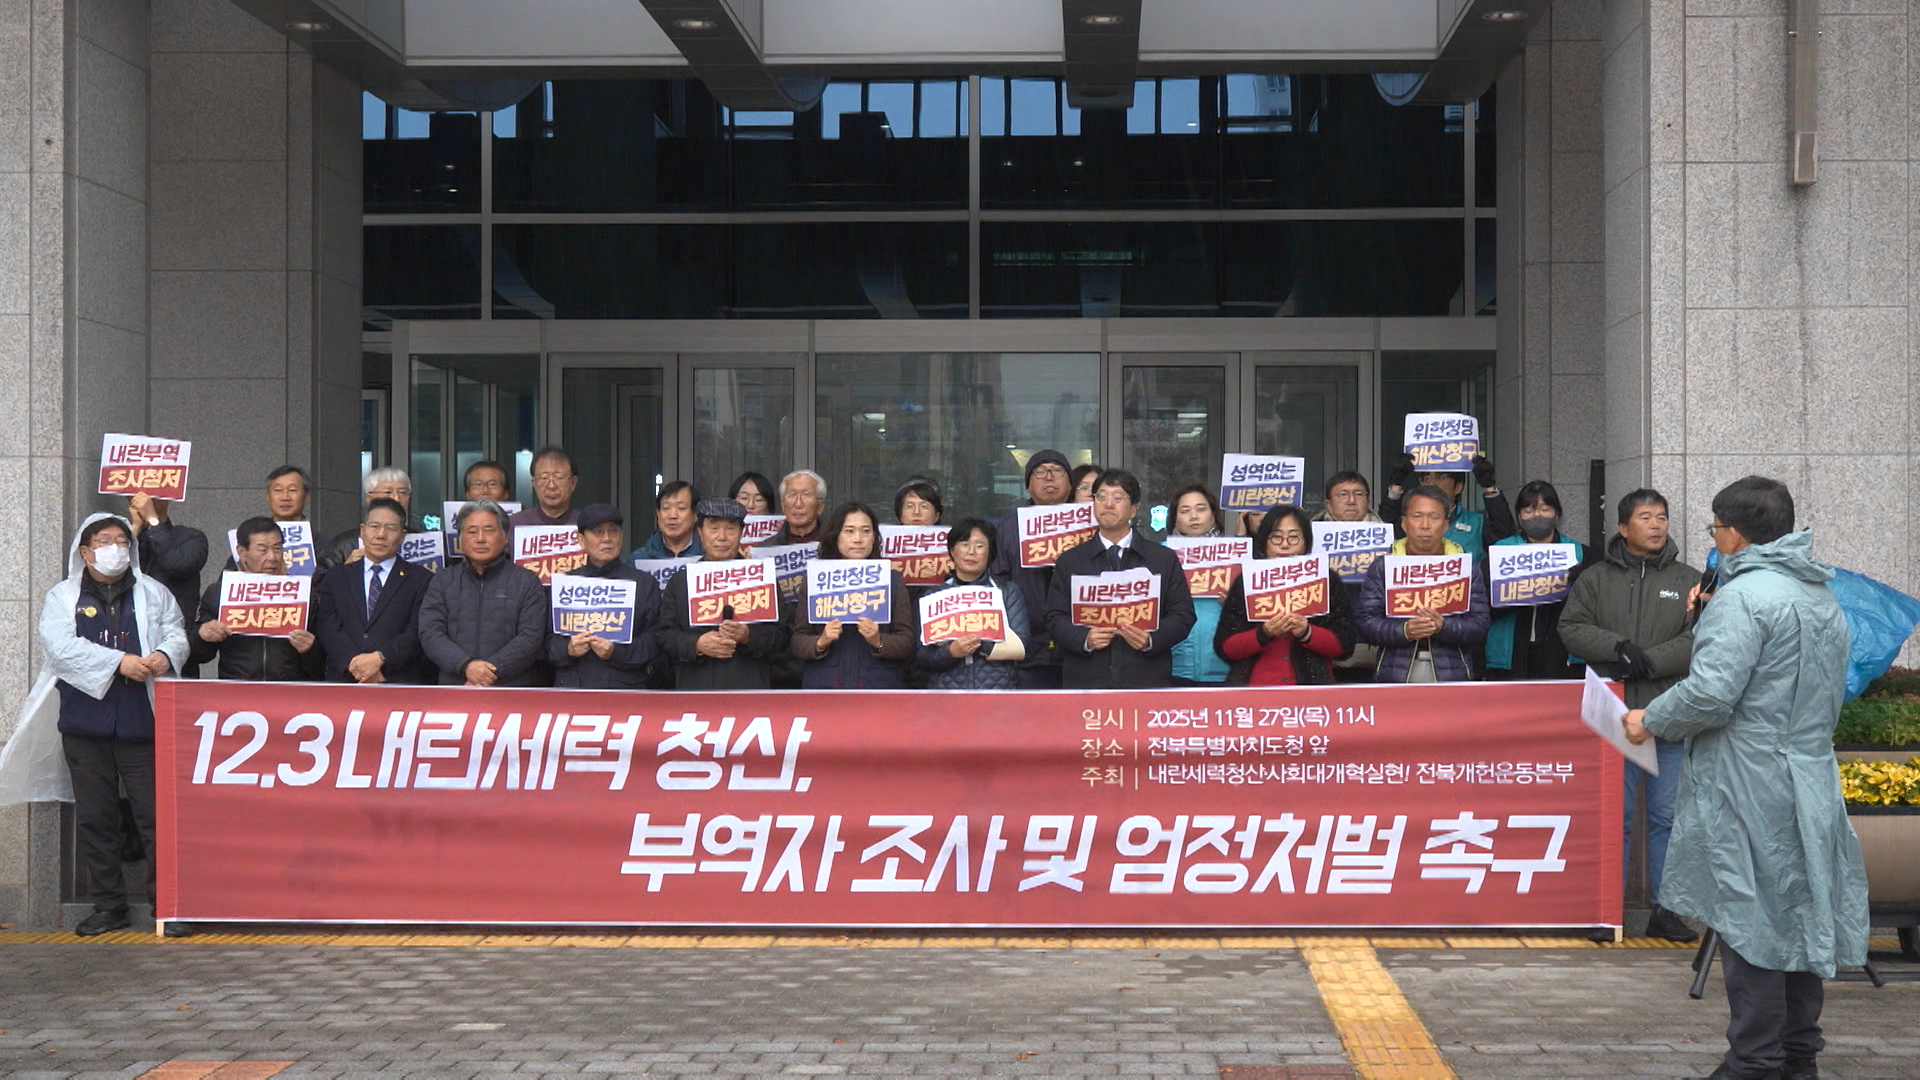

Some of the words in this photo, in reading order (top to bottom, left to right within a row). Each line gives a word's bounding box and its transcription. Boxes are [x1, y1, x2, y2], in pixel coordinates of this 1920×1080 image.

[1413, 419, 1474, 441] 위헌정당
[108, 444, 181, 463] 내란부역
[1410, 441, 1477, 466] 해산청구
[106, 468, 181, 490] 조사철저
[1230, 461, 1297, 482] 성역없는
[1228, 485, 1297, 506] 내란청산
[1026, 506, 1091, 536] 내란부역
[1322, 527, 1387, 551] 위헌정당
[1252, 558, 1319, 590] 내란부역
[1392, 557, 1463, 586] 내란부역
[1498, 550, 1568, 576] 성역없는
[695, 563, 764, 594] 내란부역
[816, 564, 883, 591] 위헌정당
[1079, 579, 1151, 602] 내란부역
[1189, 567, 1232, 594] 설치
[1499, 572, 1569, 601] 내란청산
[228, 581, 301, 602] 내란부역
[559, 585, 627, 606] 성역없는
[815, 589, 886, 618] 해산청구
[928, 590, 993, 618] 내란부역
[1254, 583, 1323, 616] 조사철저
[1393, 581, 1466, 612] 조사철저
[226, 607, 302, 628] 조사철저
[559, 611, 626, 633] 내란청산
[1079, 601, 1153, 625] 조사철저
[929, 613, 999, 640] 조사철저
[1081, 708, 1124, 730] 일시
[1146, 707, 1209, 728] 2025년
[1214, 707, 1254, 728] 11월
[1258, 706, 1330, 728] 27일(목)
[1336, 706, 1375, 726] 11시
[655, 713, 812, 793] 청산.
[1081, 738, 1125, 760] 장소
[1147, 735, 1303, 756] 전북특별자치도청
[1308, 735, 1330, 756] 앞
[1081, 765, 1124, 788] 주최
[1416, 762, 1575, 784] 전북개헌운동본부
[621, 813, 845, 892] 부역자
[850, 814, 1007, 892] 조사
[1017, 814, 1098, 892] 및
[1108, 812, 1408, 895] 엄정처벌
[1418, 811, 1572, 894] 촉구
